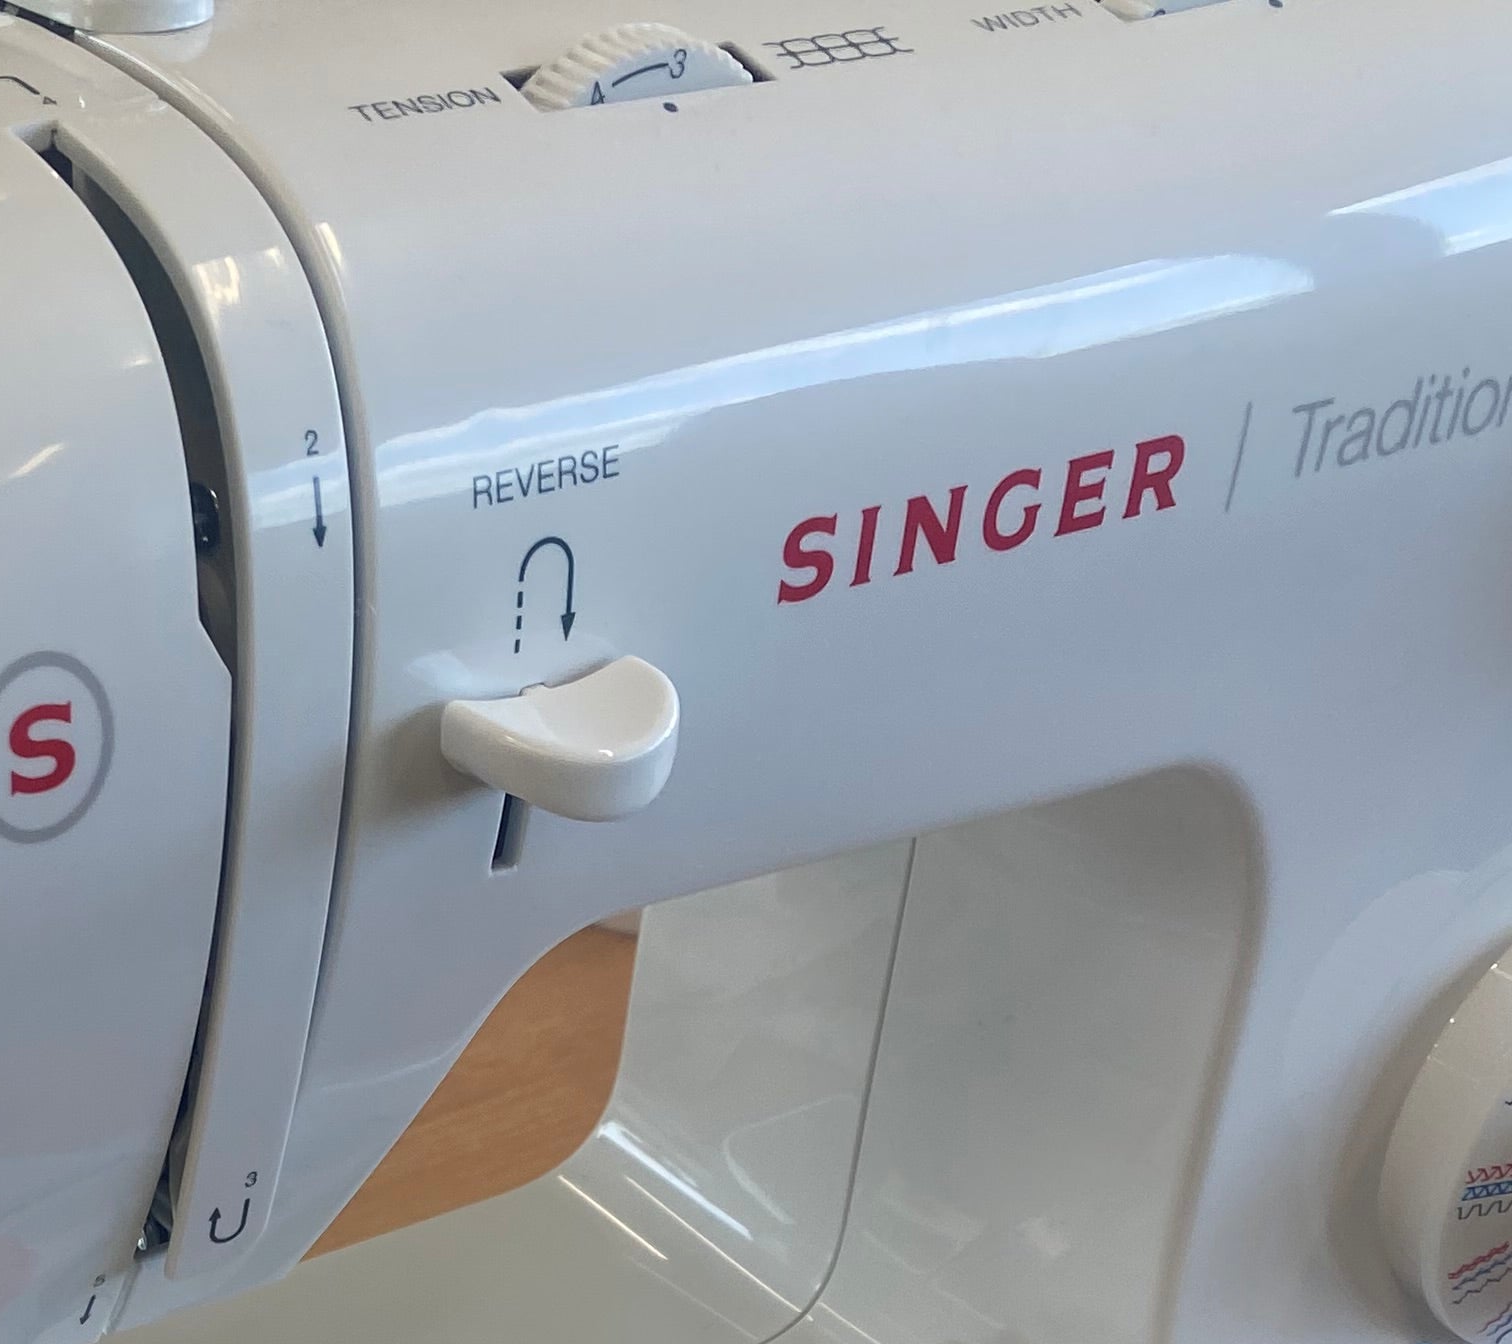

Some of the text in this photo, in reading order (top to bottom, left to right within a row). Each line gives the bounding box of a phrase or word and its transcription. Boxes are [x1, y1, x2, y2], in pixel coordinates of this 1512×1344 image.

[970, 3, 1082, 32] WIDTH
[669, 48, 687, 79] 3
[348, 87, 501, 122] TENSION
[590, 81, 605, 105] 4
[304, 429, 319, 456] 2
[472, 445, 620, 509] REVERSE
[778, 434, 1185, 604] SINGER
[8, 700, 76, 797] S
